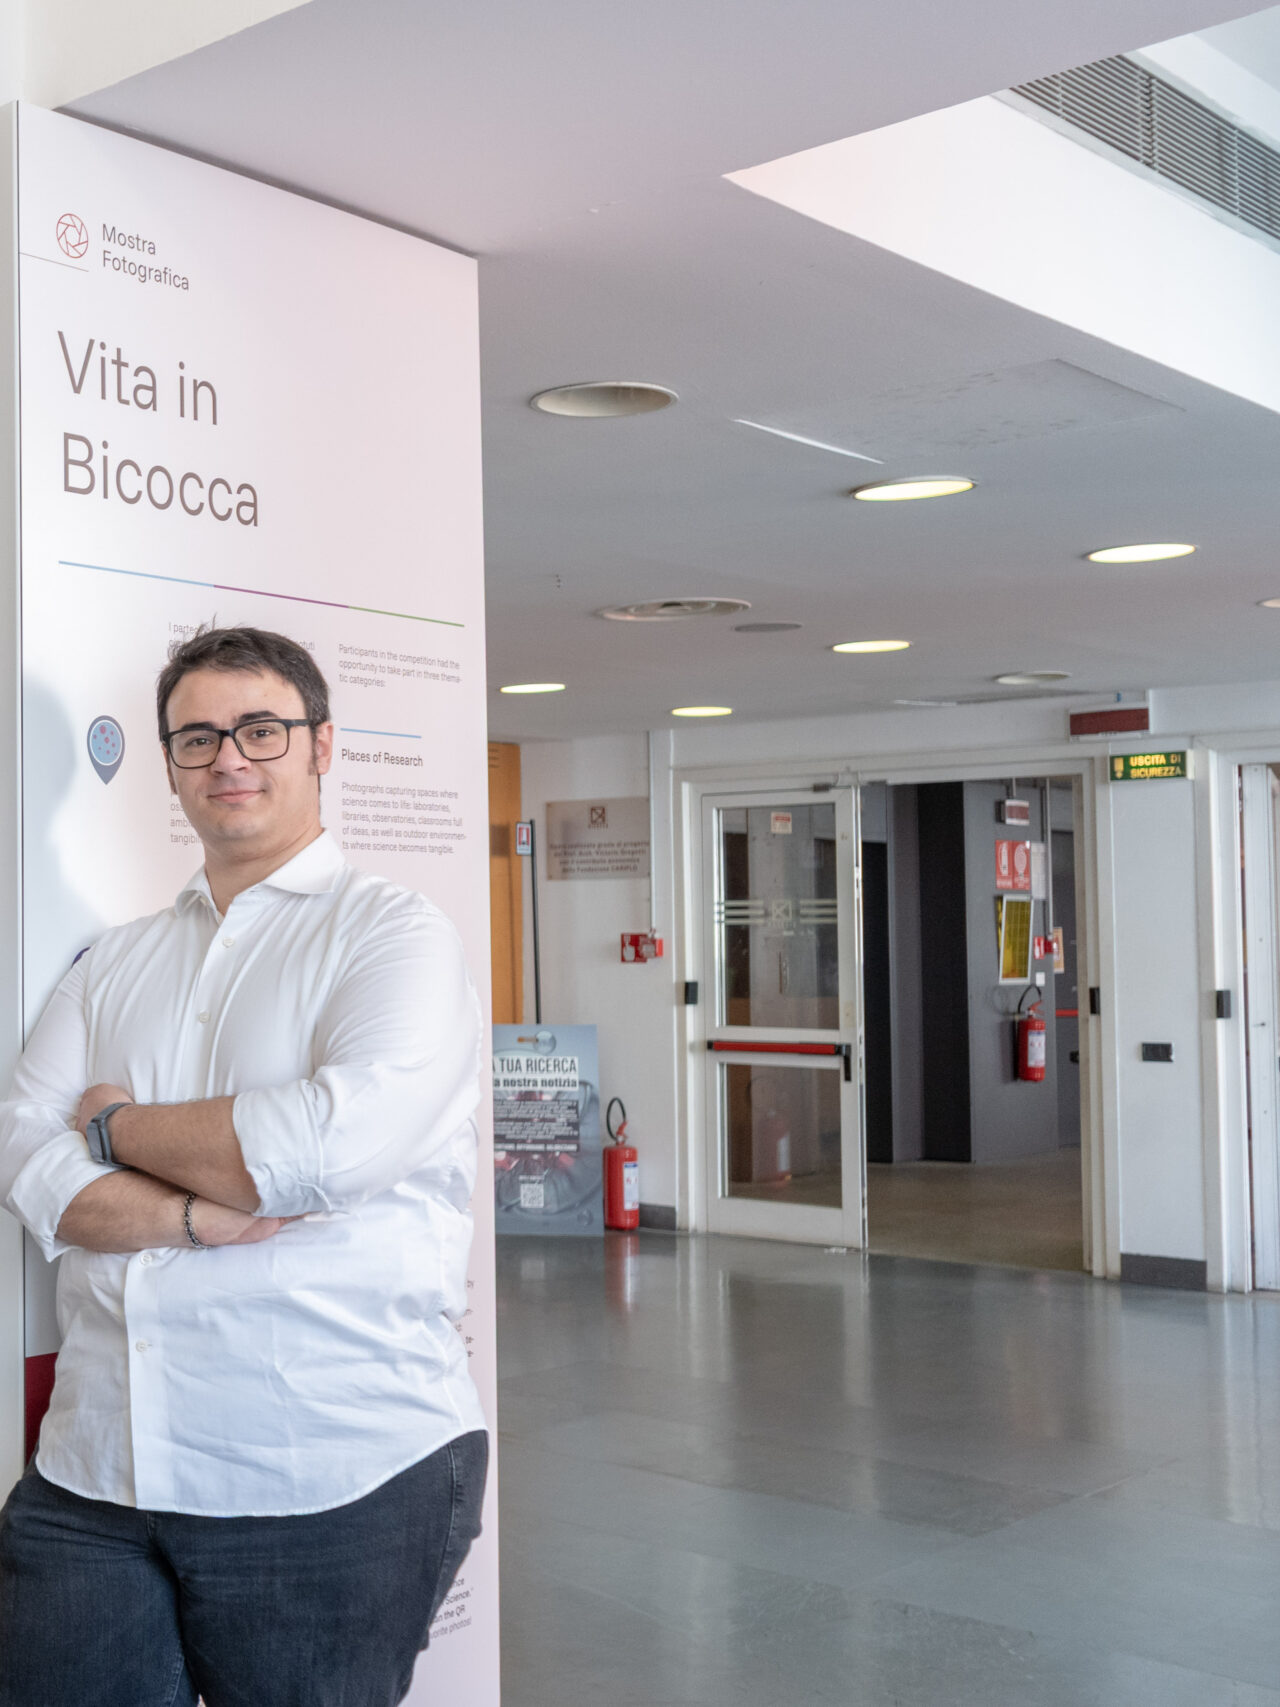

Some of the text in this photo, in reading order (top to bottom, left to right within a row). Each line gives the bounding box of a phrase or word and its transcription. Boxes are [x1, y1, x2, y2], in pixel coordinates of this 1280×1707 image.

[102, 223, 156, 256] Mostra
[102, 250, 189, 291] Fotografica
[57, 330, 217, 425] Vita in
[63, 432, 258, 527] Bicocca
[339, 643, 460, 670] Participants in the competition had the
[339, 660, 463, 683] opportunity to take part in three thema-
[339, 673, 386, 688] tic categories:
[341, 748, 424, 767] Places of Research
[1129, 753, 1182, 767] USCITA DI
[1129, 766, 1182, 779] SICUREZZA
[341, 782, 459, 799] Photographs capturing spaces where
[341, 797, 368, 808] science
[369, 799, 391, 809] comes
[392, 800, 399, 809] to
[342, 811, 371, 823] libraries,
[418, 815, 452, 826] classrooms
[453, 817, 463, 827] full
[342, 825, 350, 836] of
[351, 826, 371, 837] ideas,
[371, 828, 379, 837] as
[380, 827, 393, 837] well
[394, 829, 402, 838] as
[403, 829, 428, 839] outdoor
[342, 840, 349, 849] ts
[350, 841, 371, 851] where
[373, 842, 397, 852] science
[399, 843, 427, 853] becomes
[499, 1057, 522, 1074] TUA
[525, 1057, 577, 1074] RICERCA
[493, 1076, 577, 1088] a nostra notizia
[444, 1610, 455, 1620] the
[455, 1604, 466, 1617] QR
